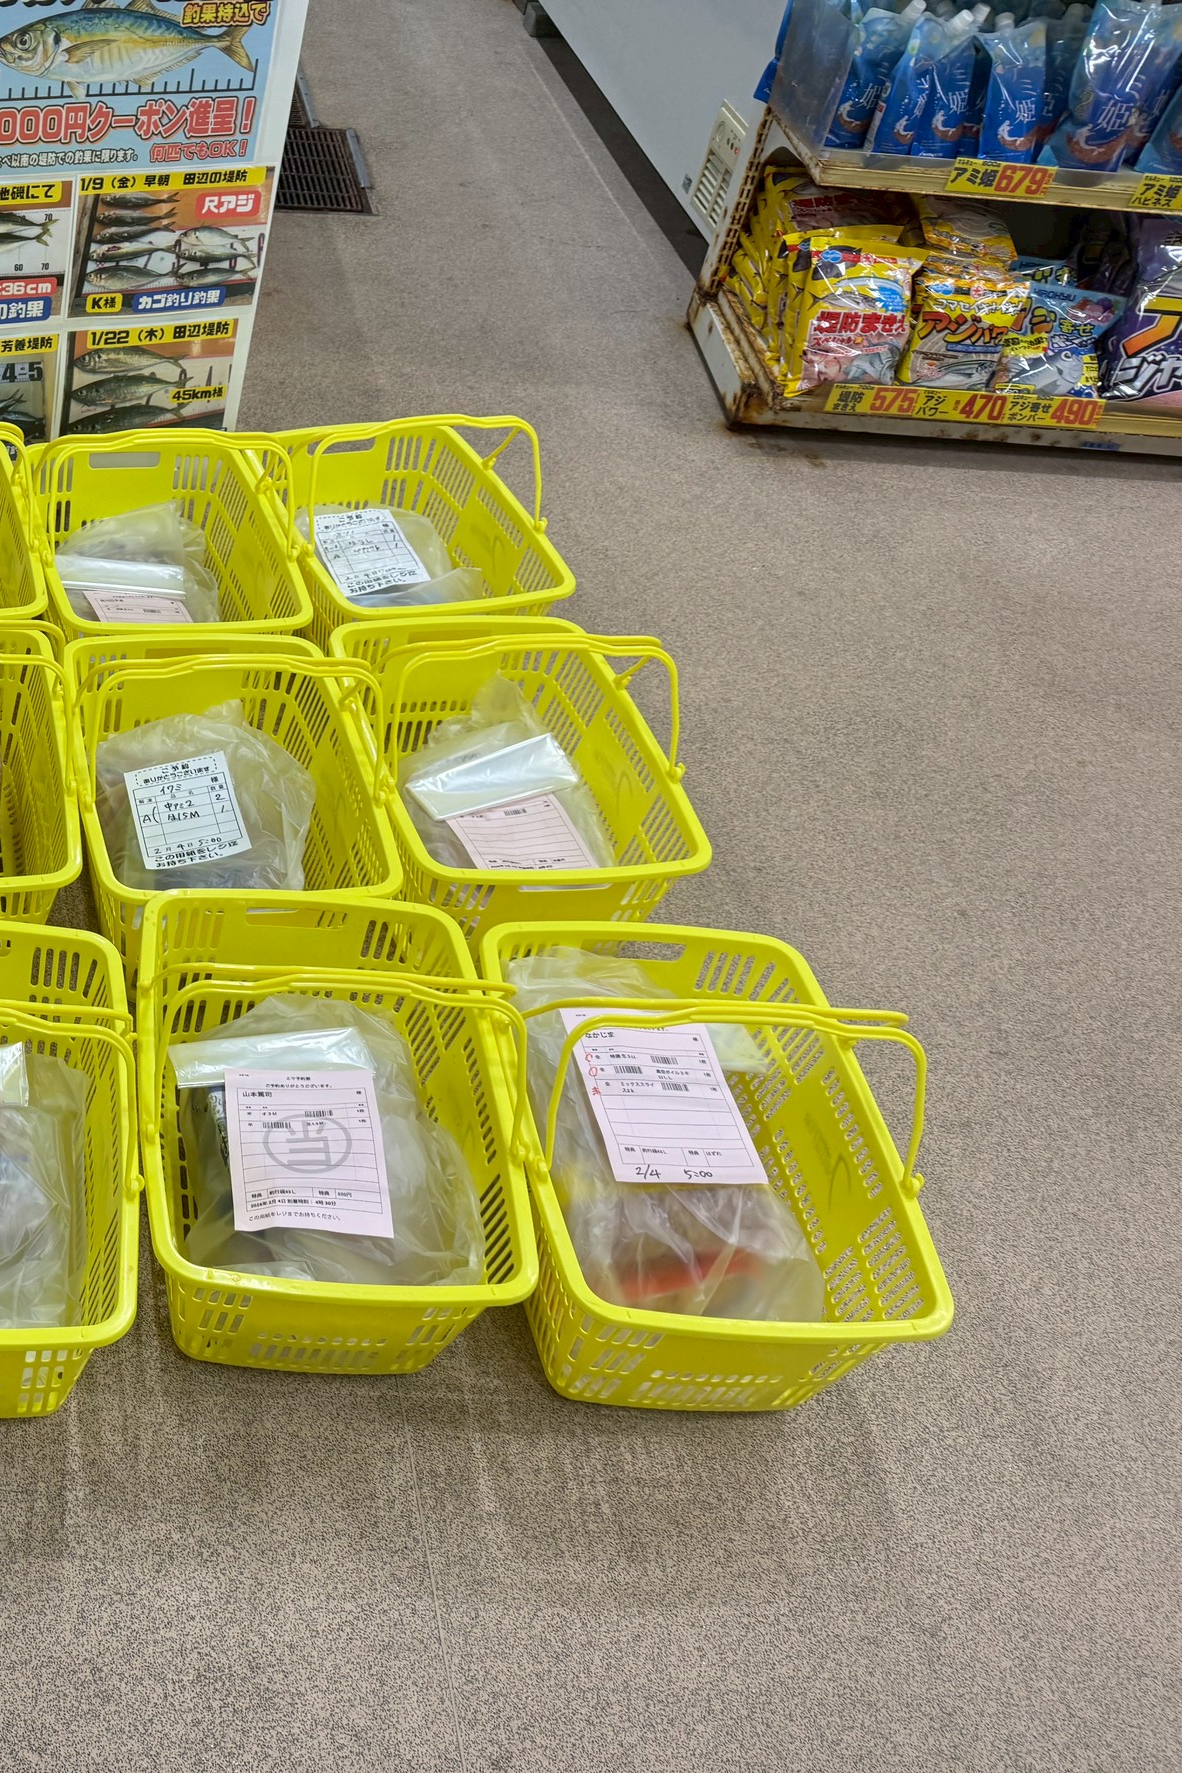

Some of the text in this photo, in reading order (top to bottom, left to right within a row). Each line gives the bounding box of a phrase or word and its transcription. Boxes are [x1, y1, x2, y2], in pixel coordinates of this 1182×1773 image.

[182, 2, 270, 27] 釣果持込で
[949, 166, 1000, 188] アミ姫
[993, 164, 1049, 196] 679
[201, 193, 256, 215] 尺アジ
[91, 296, 118, 311] K様
[137, 288, 221, 311] カゴ釣り釣果
[173, 320, 231, 340] 田辺堤防
[171, 387, 225, 402] 45km様
[837, 387, 915, 413] 堤防 575
[918, 406, 949, 418] パワー
[922, 394, 947, 407] アジ
[958, 394, 1008, 422] 470
[1008, 398, 1098, 426] アジ寄せ 490
[635, 1164, 662, 1180] 2/4
